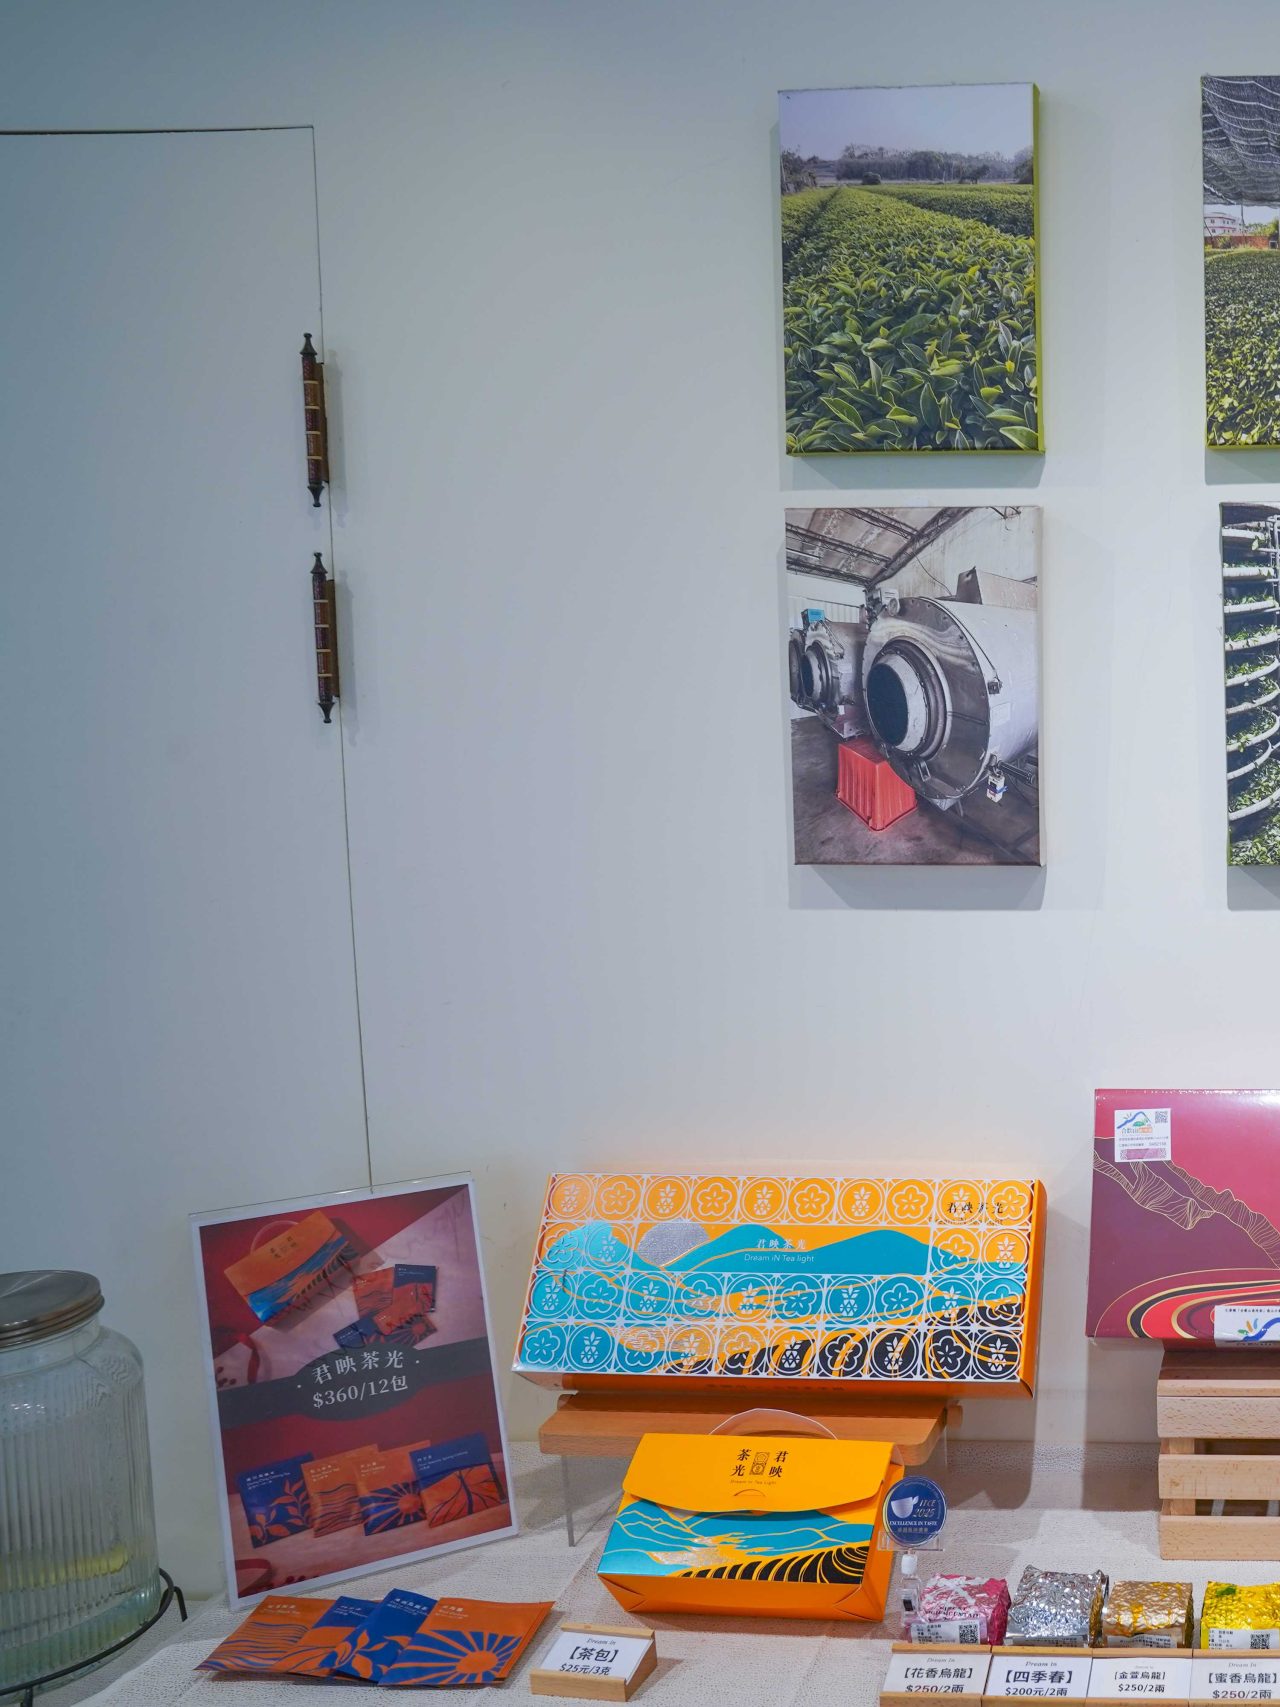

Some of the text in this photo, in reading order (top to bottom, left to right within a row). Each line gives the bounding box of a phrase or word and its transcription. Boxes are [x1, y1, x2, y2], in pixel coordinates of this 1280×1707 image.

[756, 1238, 806, 1249] 君映茶光
[783, 1254, 795, 1262] Tea
[797, 1255, 815, 1264] light
[312, 1350, 404, 1385] 君映茶光
[313, 1375, 408, 1408] $360/12包
[730, 1449, 752, 1477] 茶光
[768, 1450, 789, 1478] 君映
[570, 1646, 619, 1663] 【茶包】
[560, 1663, 612, 1676] $25元/3克
[904, 1667, 974, 1679] 【花香烏龍】
[1005, 1670, 1073, 1684] 【四季春】
[1208, 1672, 1277, 1684] 【蜜香烏龍】
[1005, 1687, 1068, 1697] $200元/2兩
[1118, 1683, 1166, 1693] $250/2兩
[1212, 1689, 1272, 1699] $250/2兩
